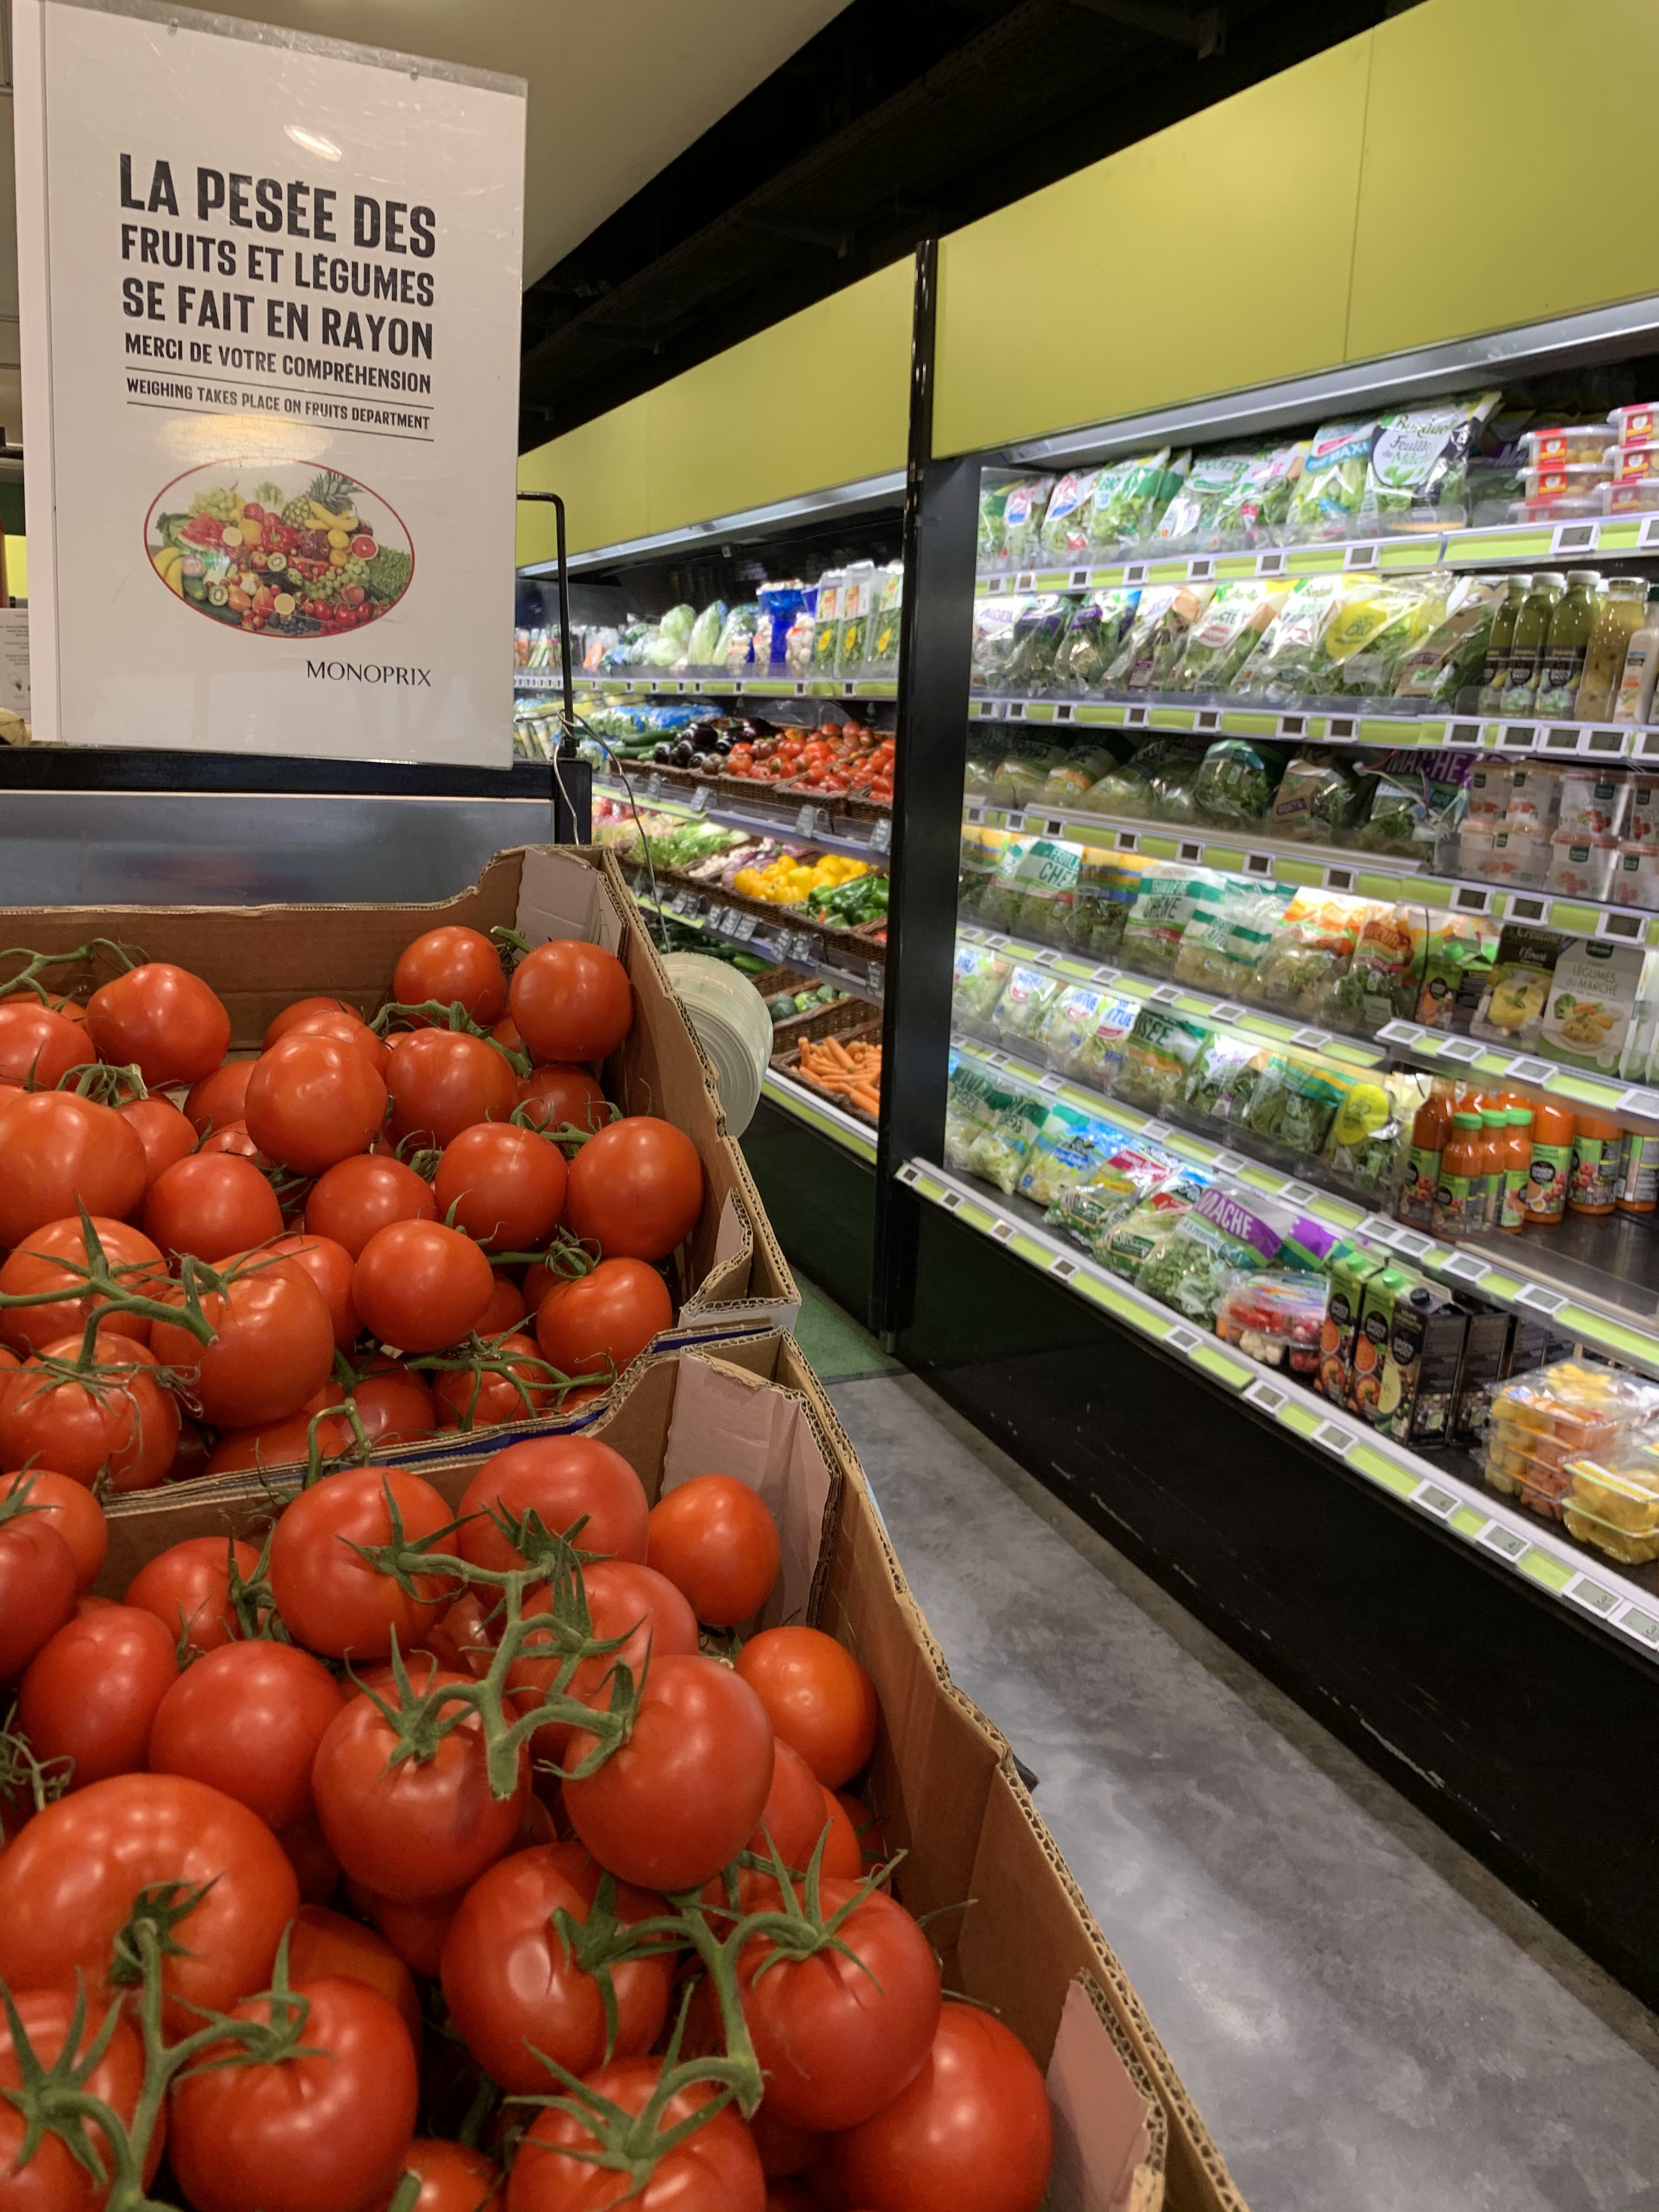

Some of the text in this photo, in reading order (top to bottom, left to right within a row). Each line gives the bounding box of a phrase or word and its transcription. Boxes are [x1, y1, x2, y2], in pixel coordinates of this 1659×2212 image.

[120, 153, 436, 259] LA PESÉE DES
[121, 223, 435, 307] FRUITS ET LÉGUMES
[122, 277, 433, 360] SE FAIT EN RAYON
[125, 332, 431, 394] MERCI DE VOTRE COMPRÉHENSION
[126, 377, 430, 430] WEIGHING TAKES PLACE ON FRUITS DEPARTMENT
[306, 660, 431, 687] MONOPRIX
